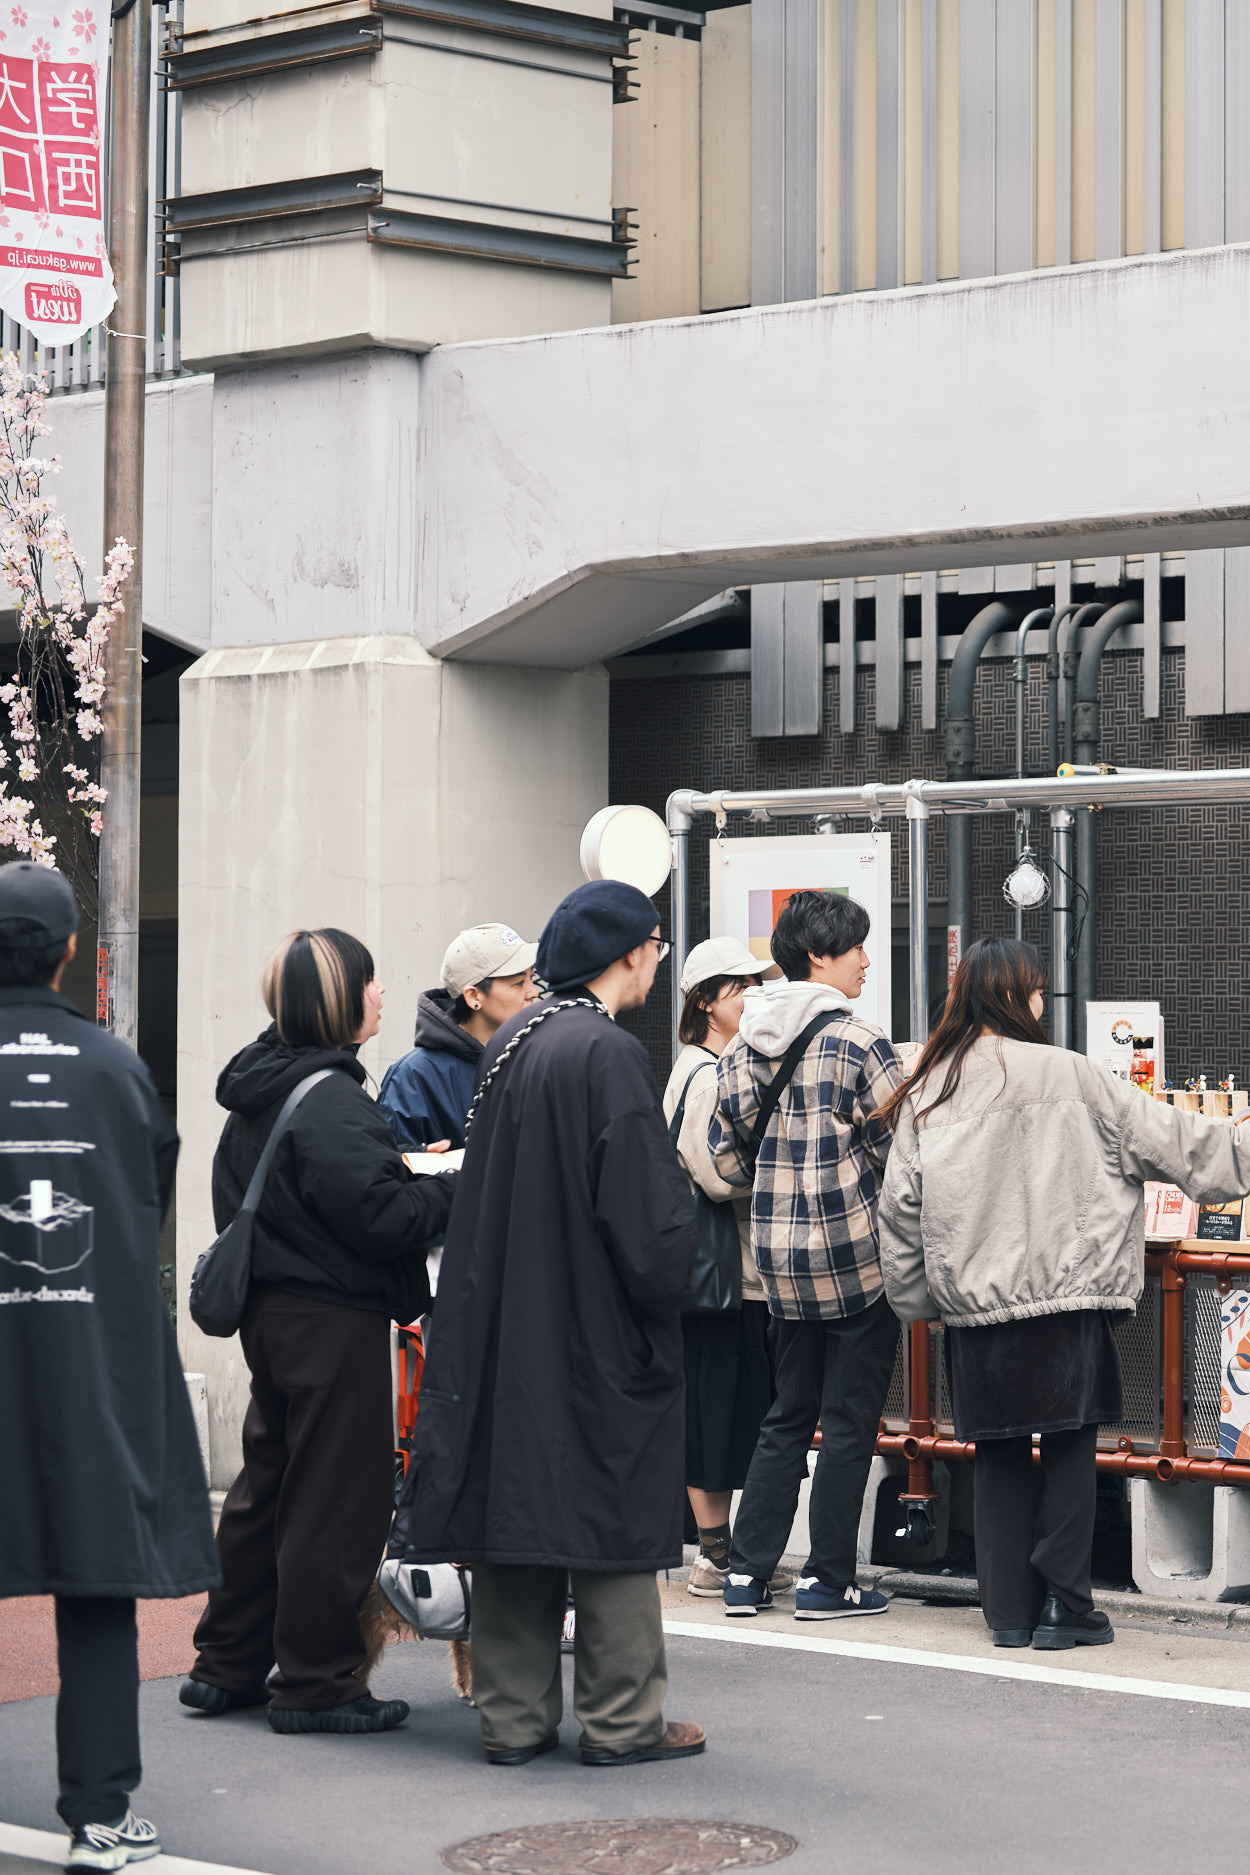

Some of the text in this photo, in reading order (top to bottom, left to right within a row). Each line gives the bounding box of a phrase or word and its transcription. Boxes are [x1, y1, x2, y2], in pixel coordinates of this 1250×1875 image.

[948, 929, 958, 980] 圧危険
[843, 1585, 861, 1605] N
